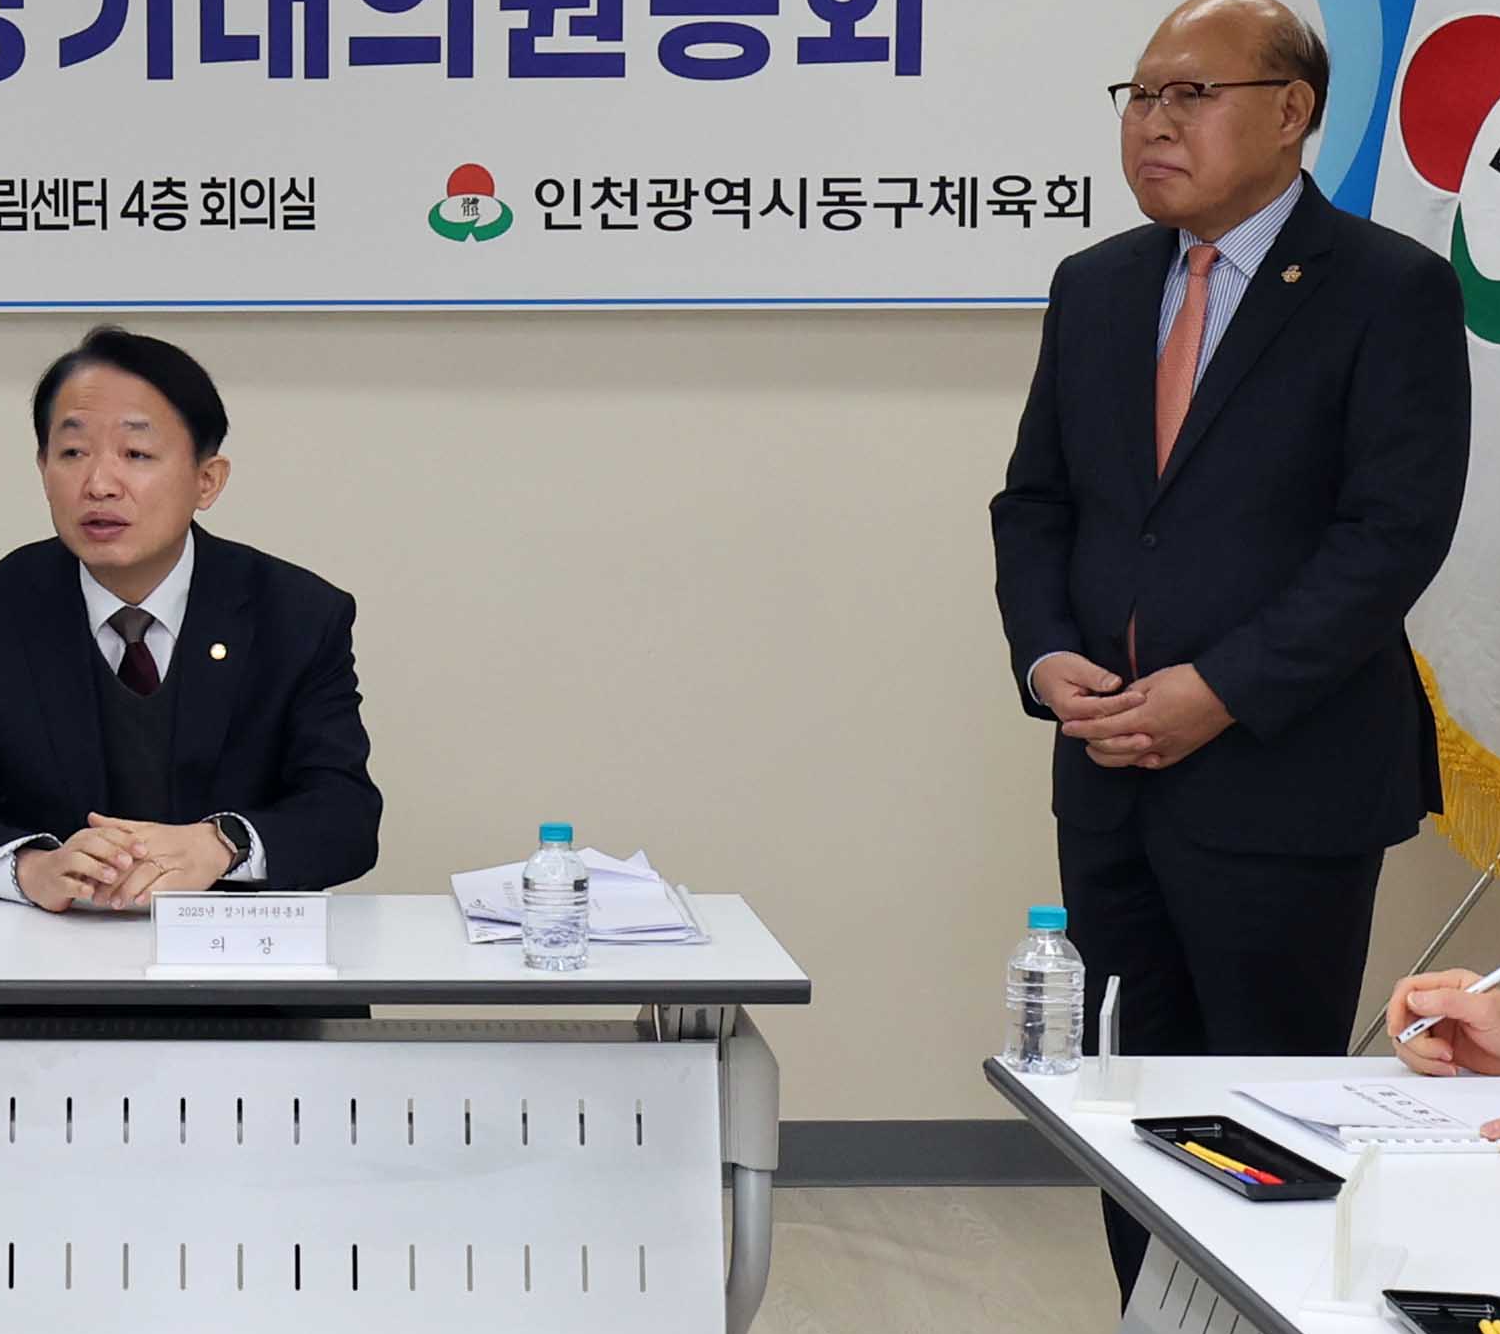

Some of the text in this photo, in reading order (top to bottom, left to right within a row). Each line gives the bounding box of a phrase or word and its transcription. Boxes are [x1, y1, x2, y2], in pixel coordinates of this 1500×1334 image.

[119, 176, 189, 232] 4층
[199, 176, 317, 232] 회의실
[534, 174, 1093, 232] 인천광역시동구체육회
